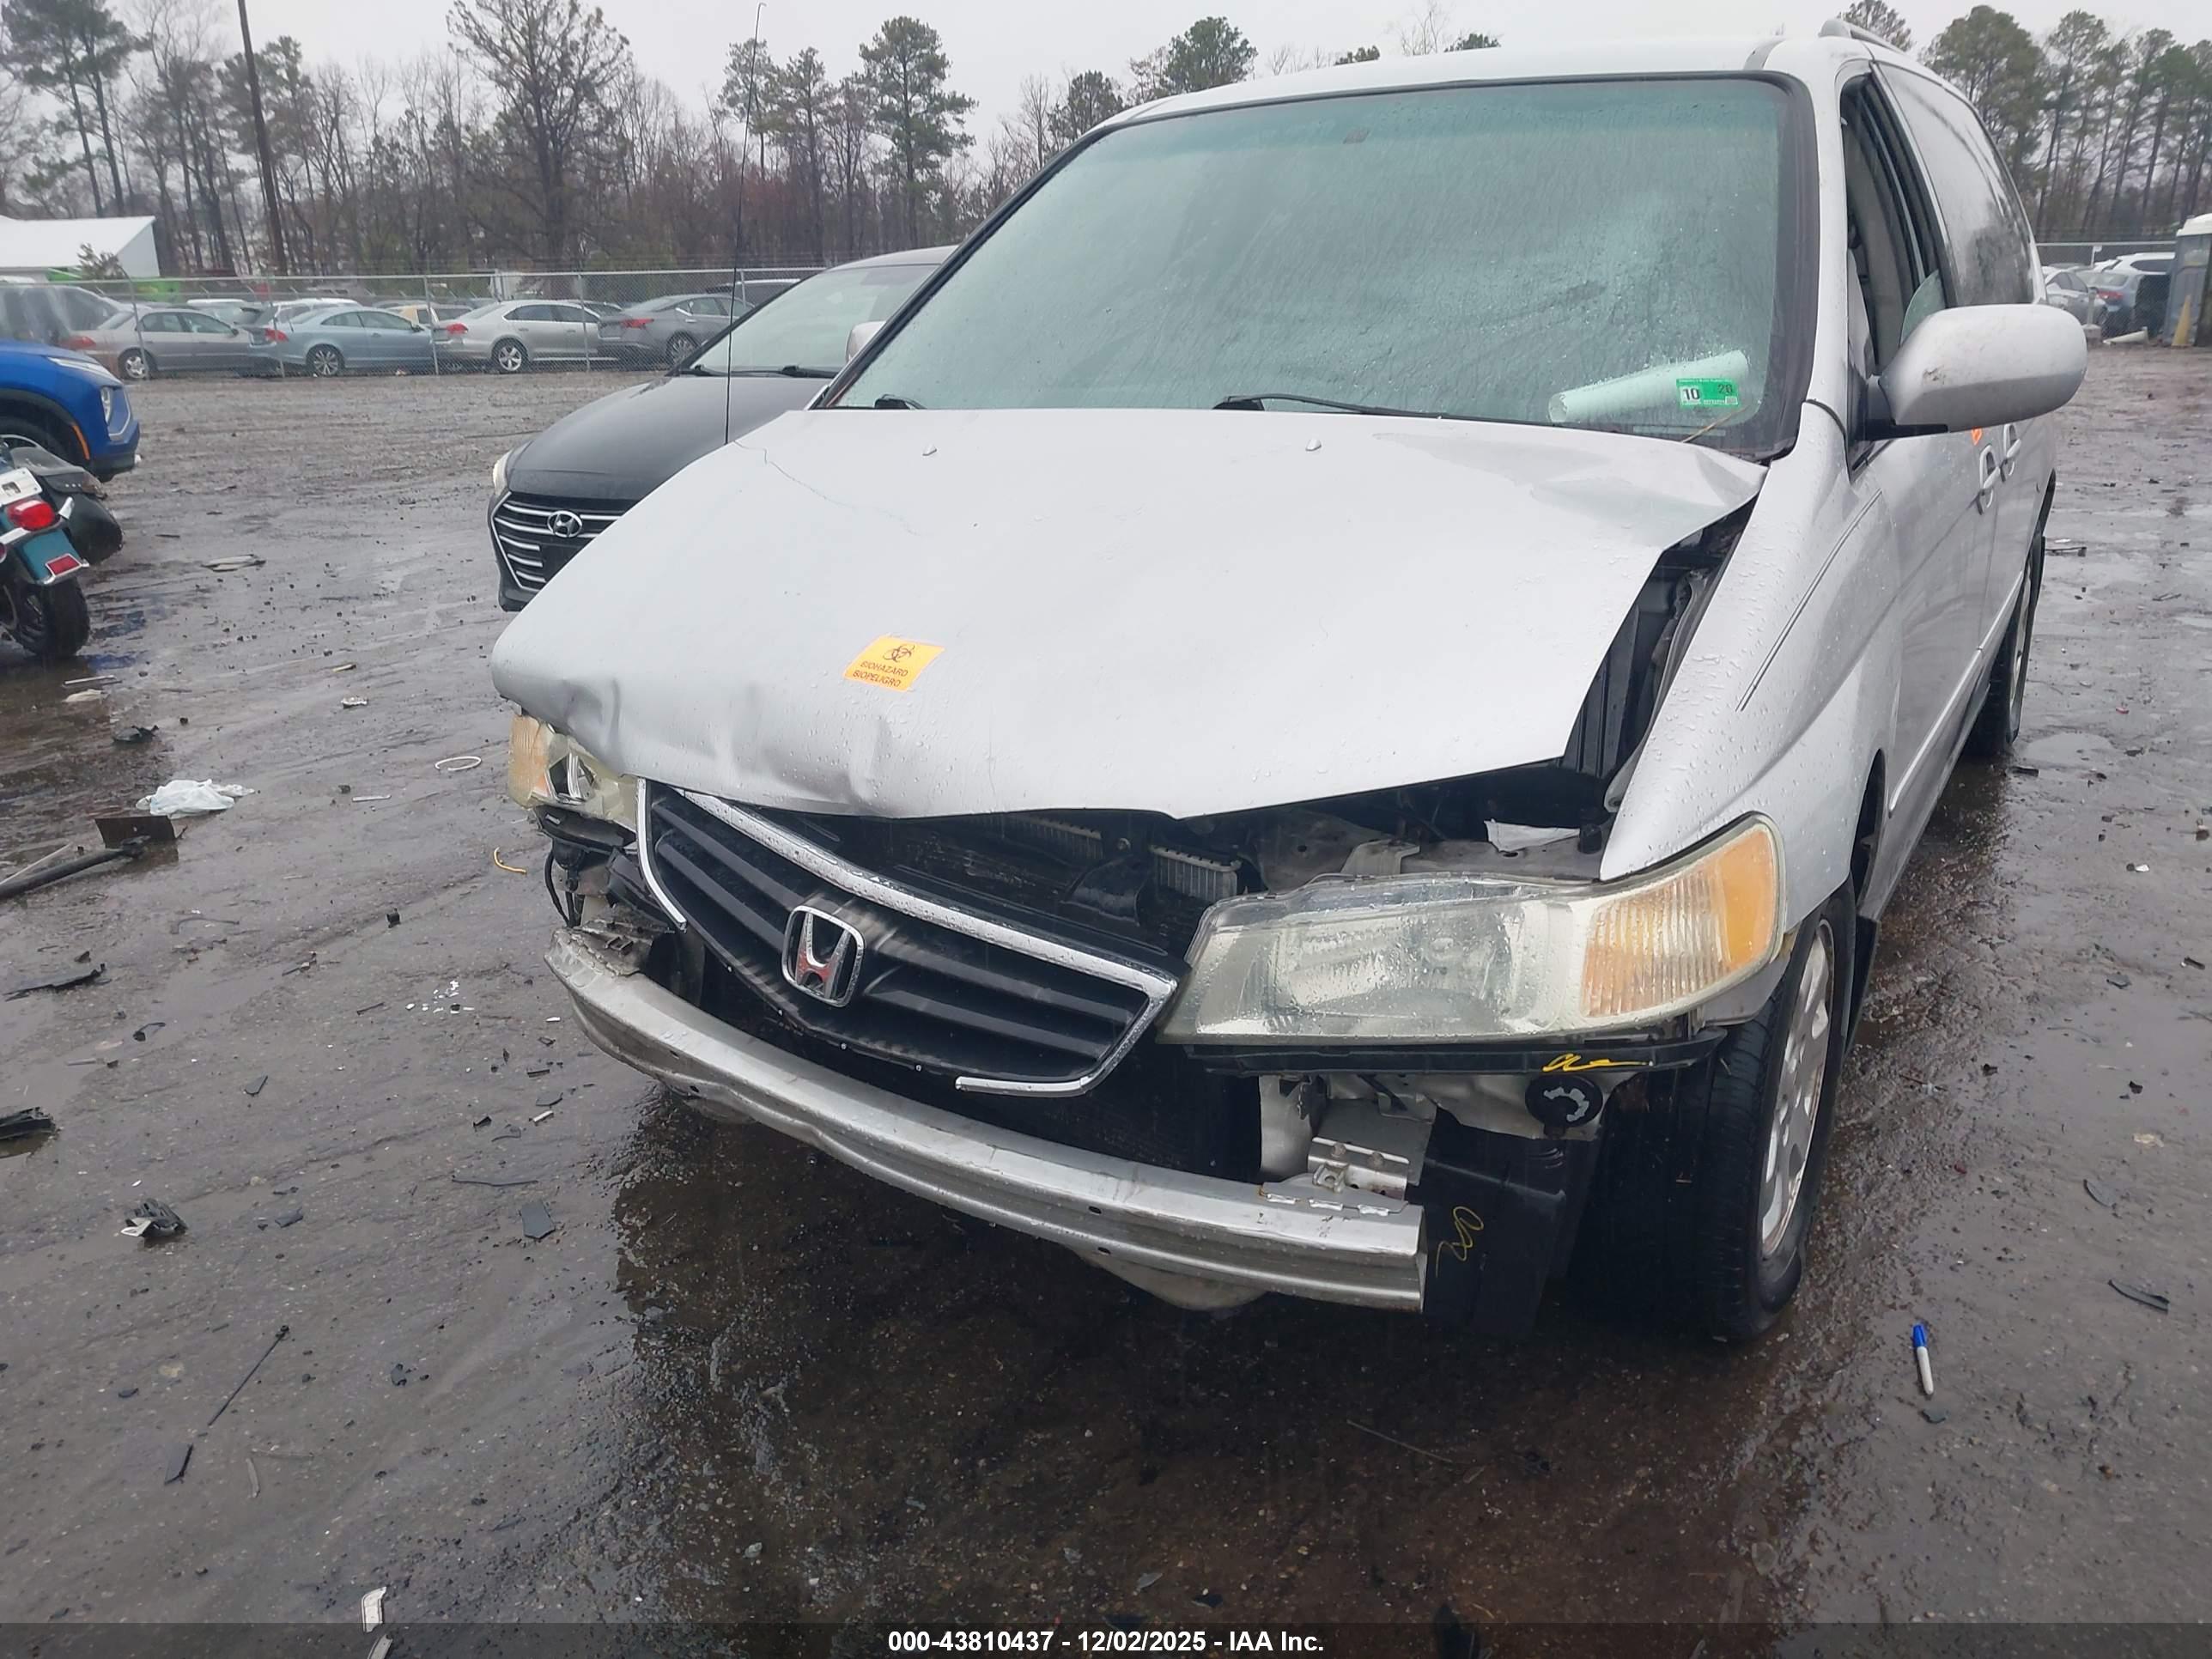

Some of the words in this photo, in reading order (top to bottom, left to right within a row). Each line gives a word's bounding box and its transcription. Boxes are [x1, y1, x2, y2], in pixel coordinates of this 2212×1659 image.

[1683, 388, 1700, 401] 10
[860, 659, 908, 678] BIOHAZARD
[852, 670, 902, 688] BIOPELIGRO
